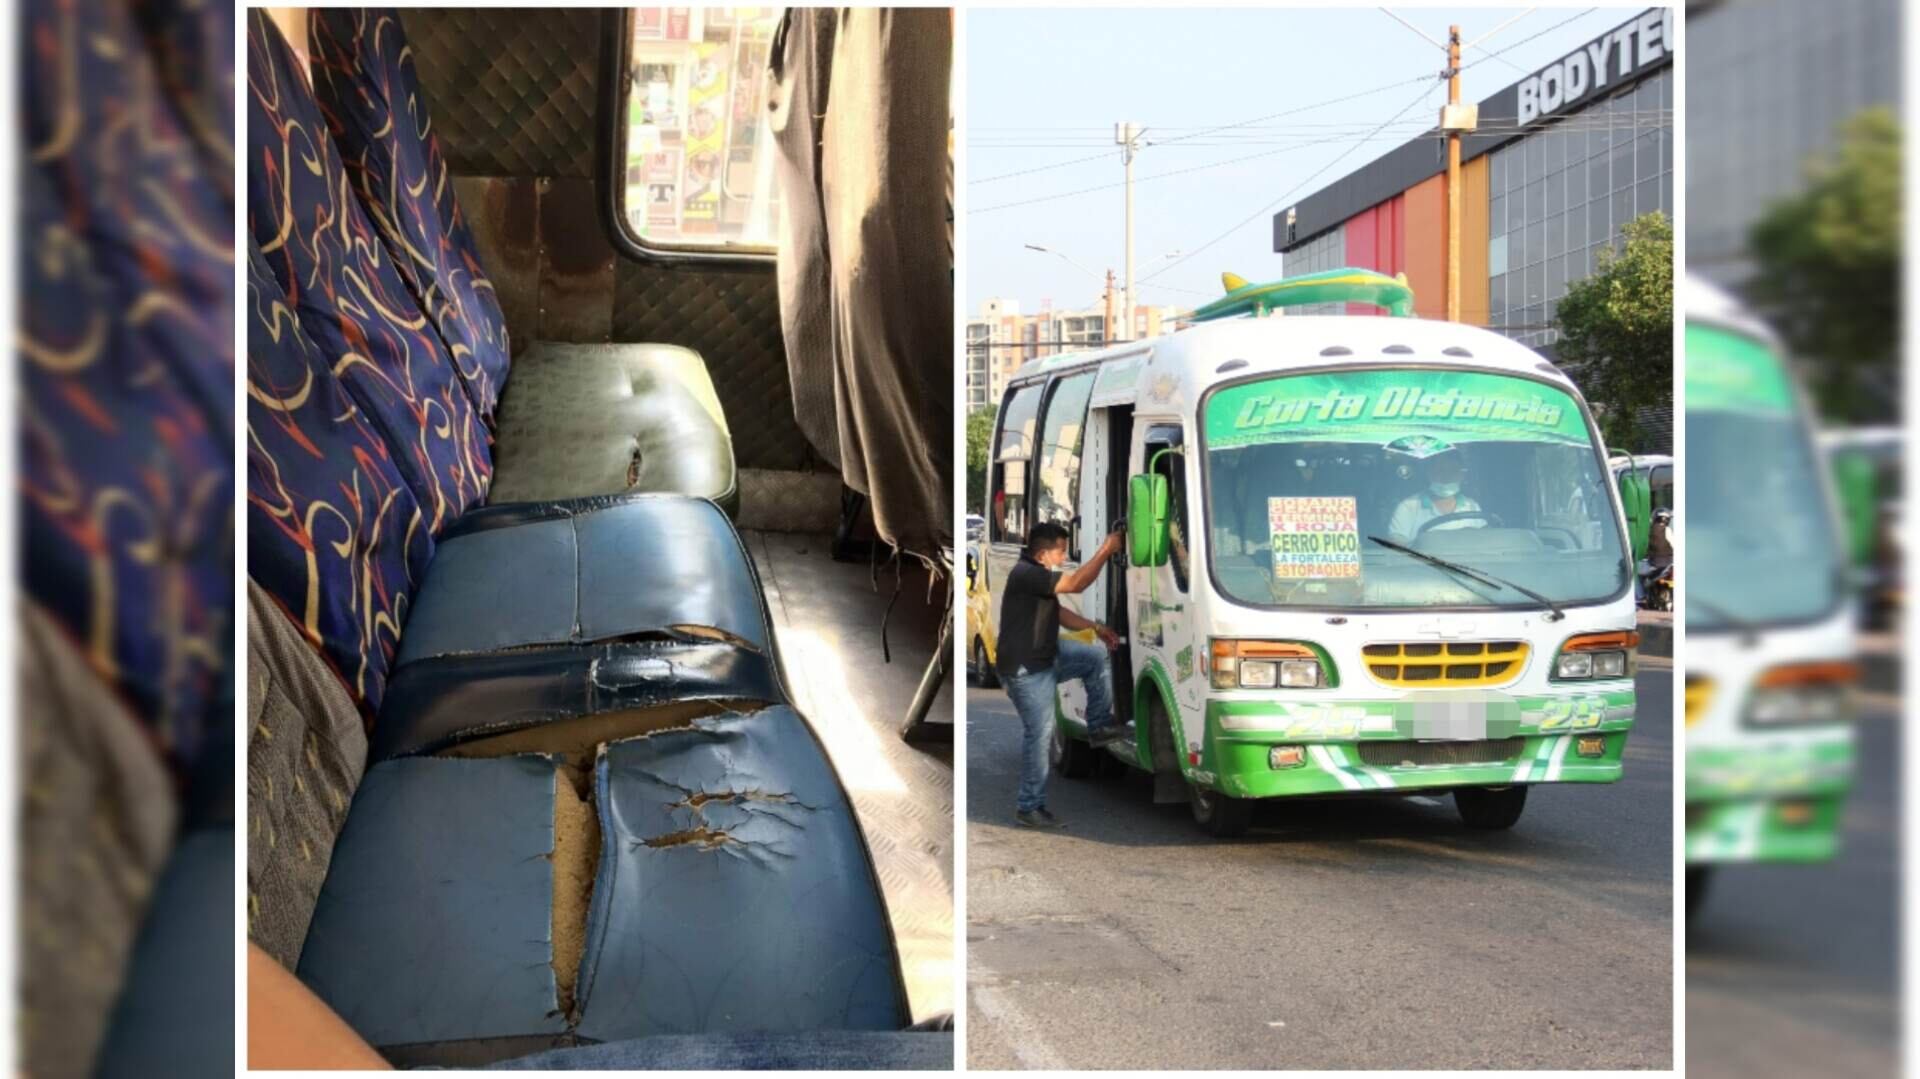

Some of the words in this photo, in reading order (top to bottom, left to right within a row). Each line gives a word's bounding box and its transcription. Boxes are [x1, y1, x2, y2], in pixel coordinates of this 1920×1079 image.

[1234, 389, 1366, 430] Corta
[1273, 523, 1287, 532] X
[1295, 523, 1355, 532] ROJA
[1272, 533, 1320, 554] CERRO
[1323, 533, 1357, 554] PICO
[1291, 554, 1358, 563] FORTALEZA
[1275, 564, 1359, 577] ESTORAQUES
[1540, 699, 1606, 731] 25
